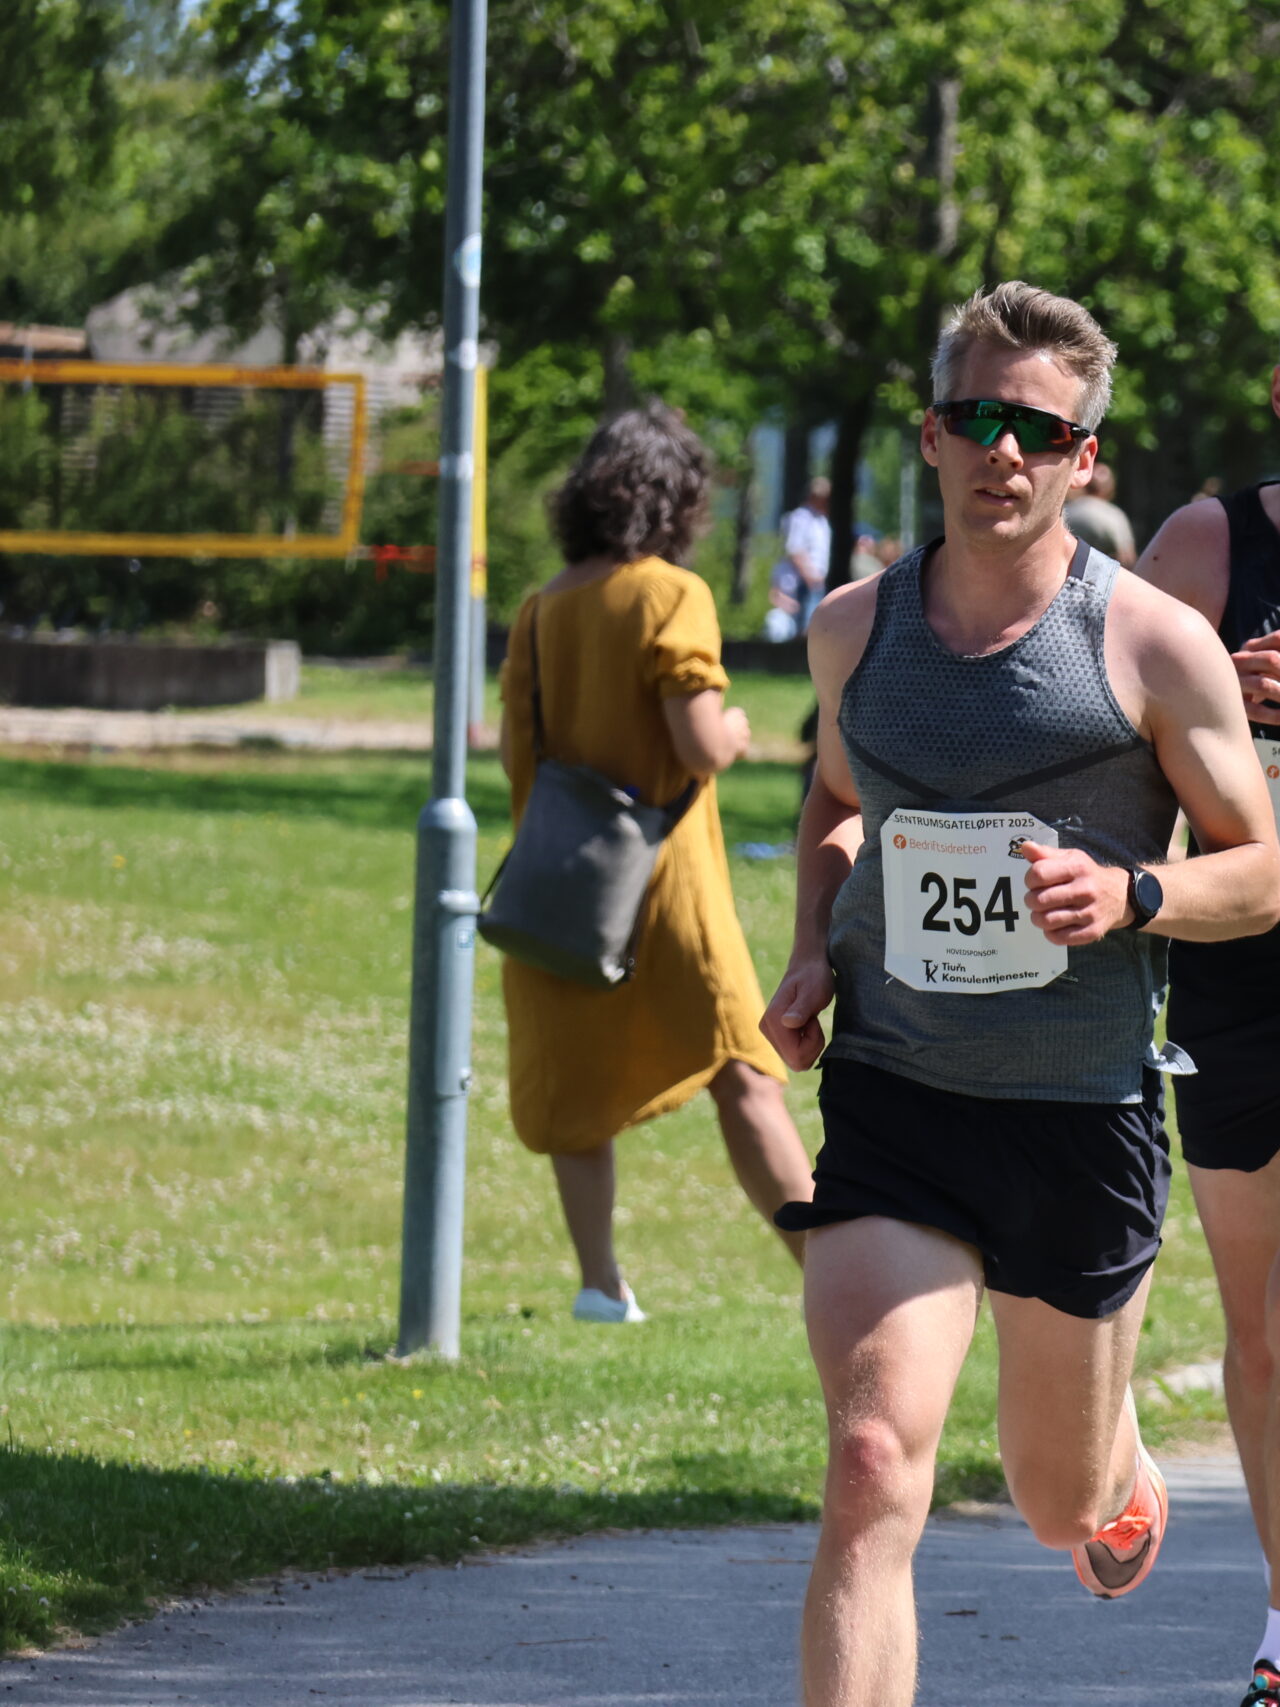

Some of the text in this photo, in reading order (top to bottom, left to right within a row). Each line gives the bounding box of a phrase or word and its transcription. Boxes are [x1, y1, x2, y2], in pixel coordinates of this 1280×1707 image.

[894, 814, 1035, 830] SENTRUMSGATELØPET 2025
[909, 838, 987, 855] Bedriftsidretten
[920, 872, 1019, 936] 254
[942, 971, 1039, 984] Konsulenttjenester
